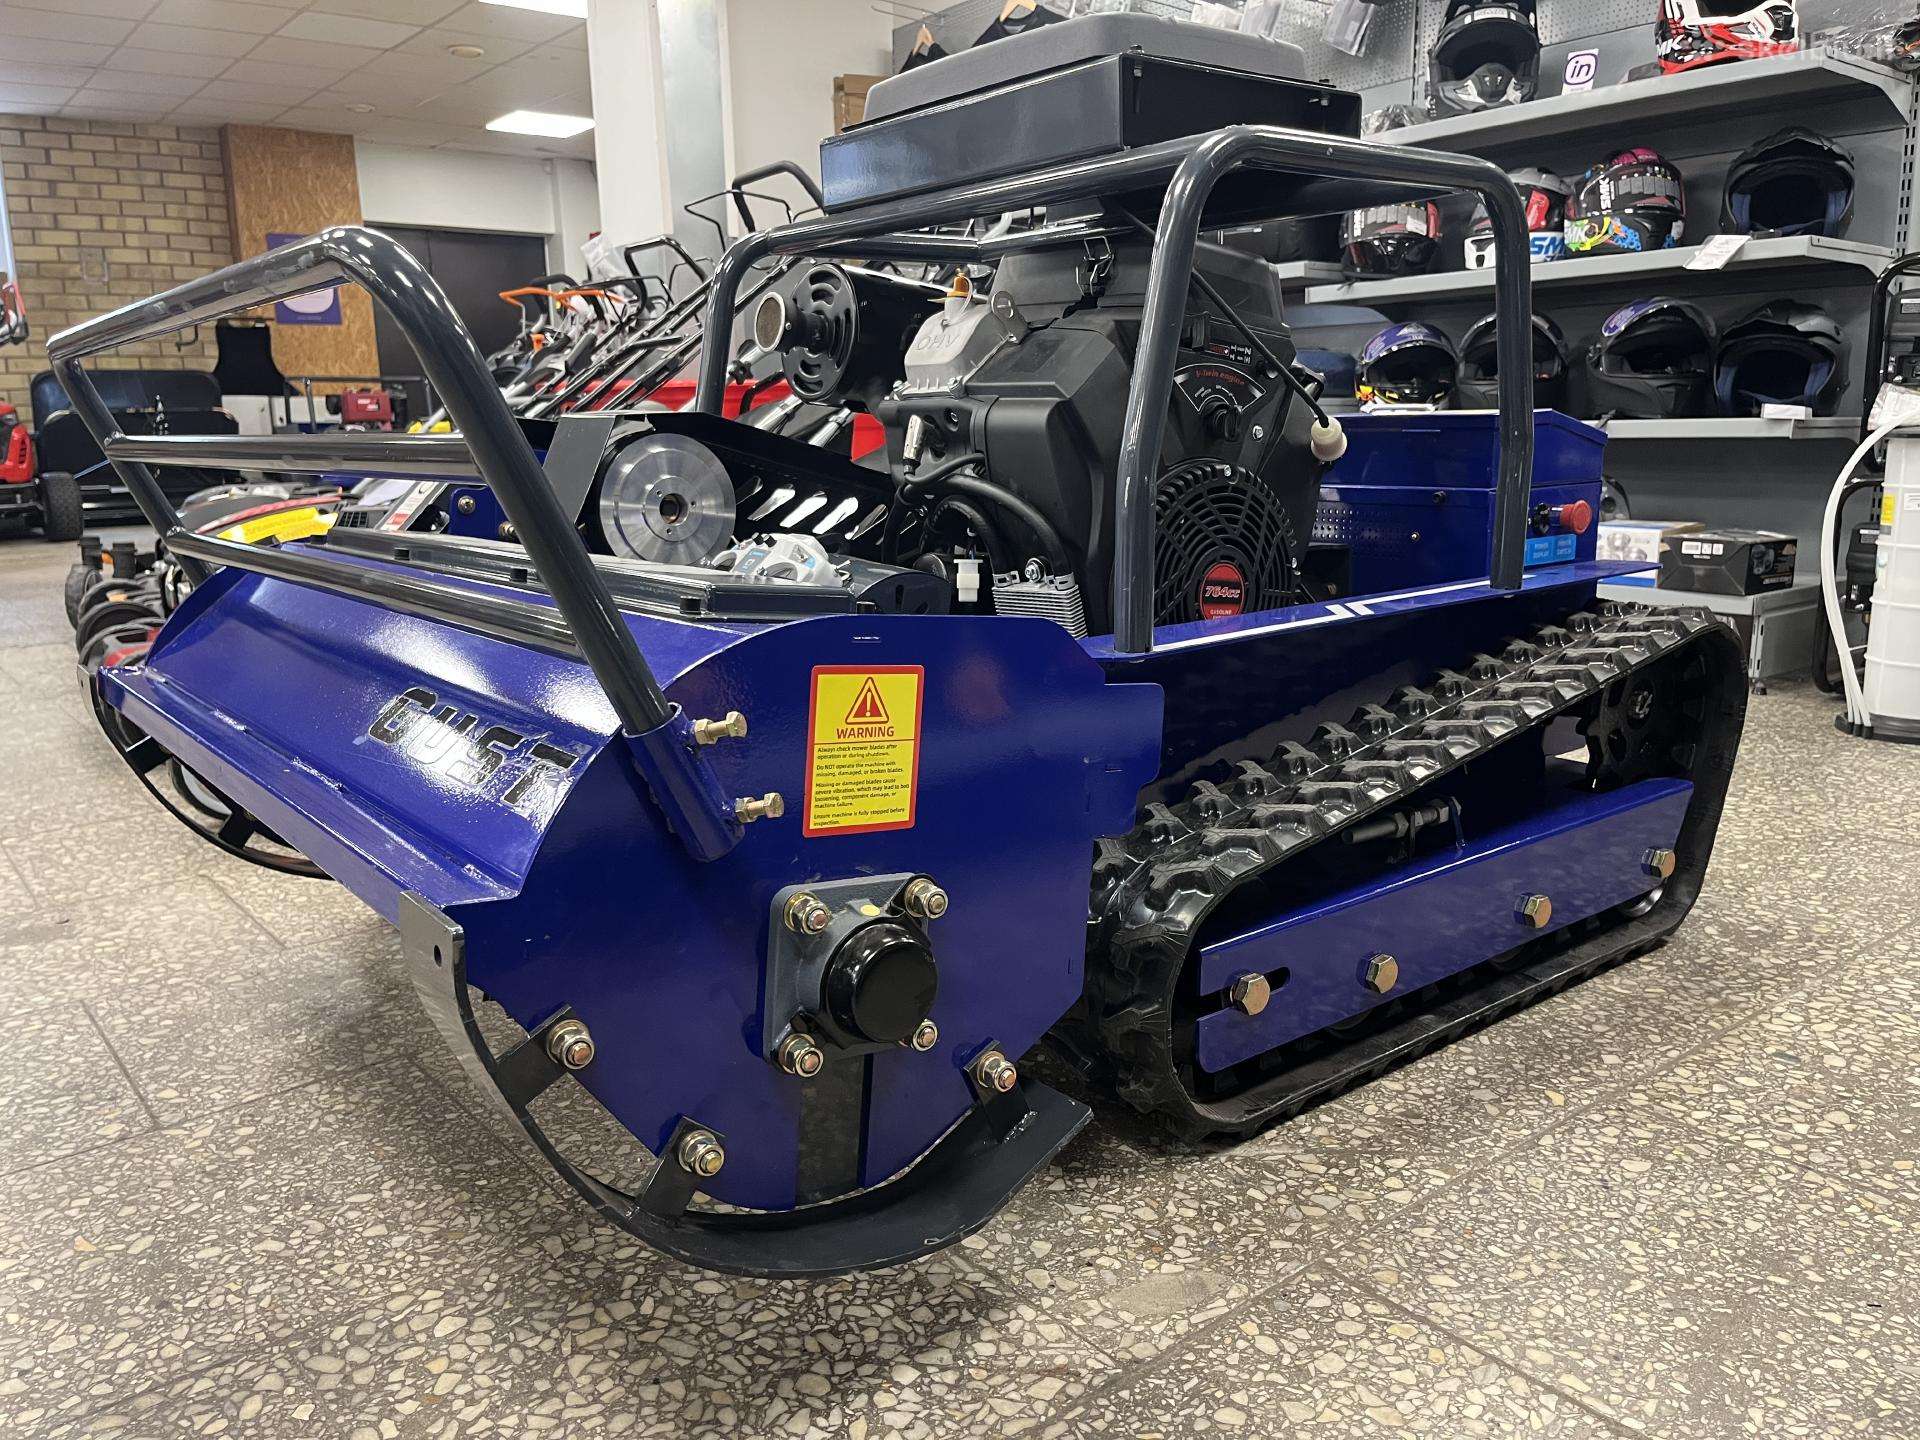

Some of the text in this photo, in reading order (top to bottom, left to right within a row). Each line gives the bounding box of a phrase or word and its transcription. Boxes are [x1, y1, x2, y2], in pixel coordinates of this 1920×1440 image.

[1570, 61, 1592, 78] in
[1530, 236, 1565, 255] SM
[1205, 585, 1240, 598] 764cc
[837, 726, 895, 739] WARNING
